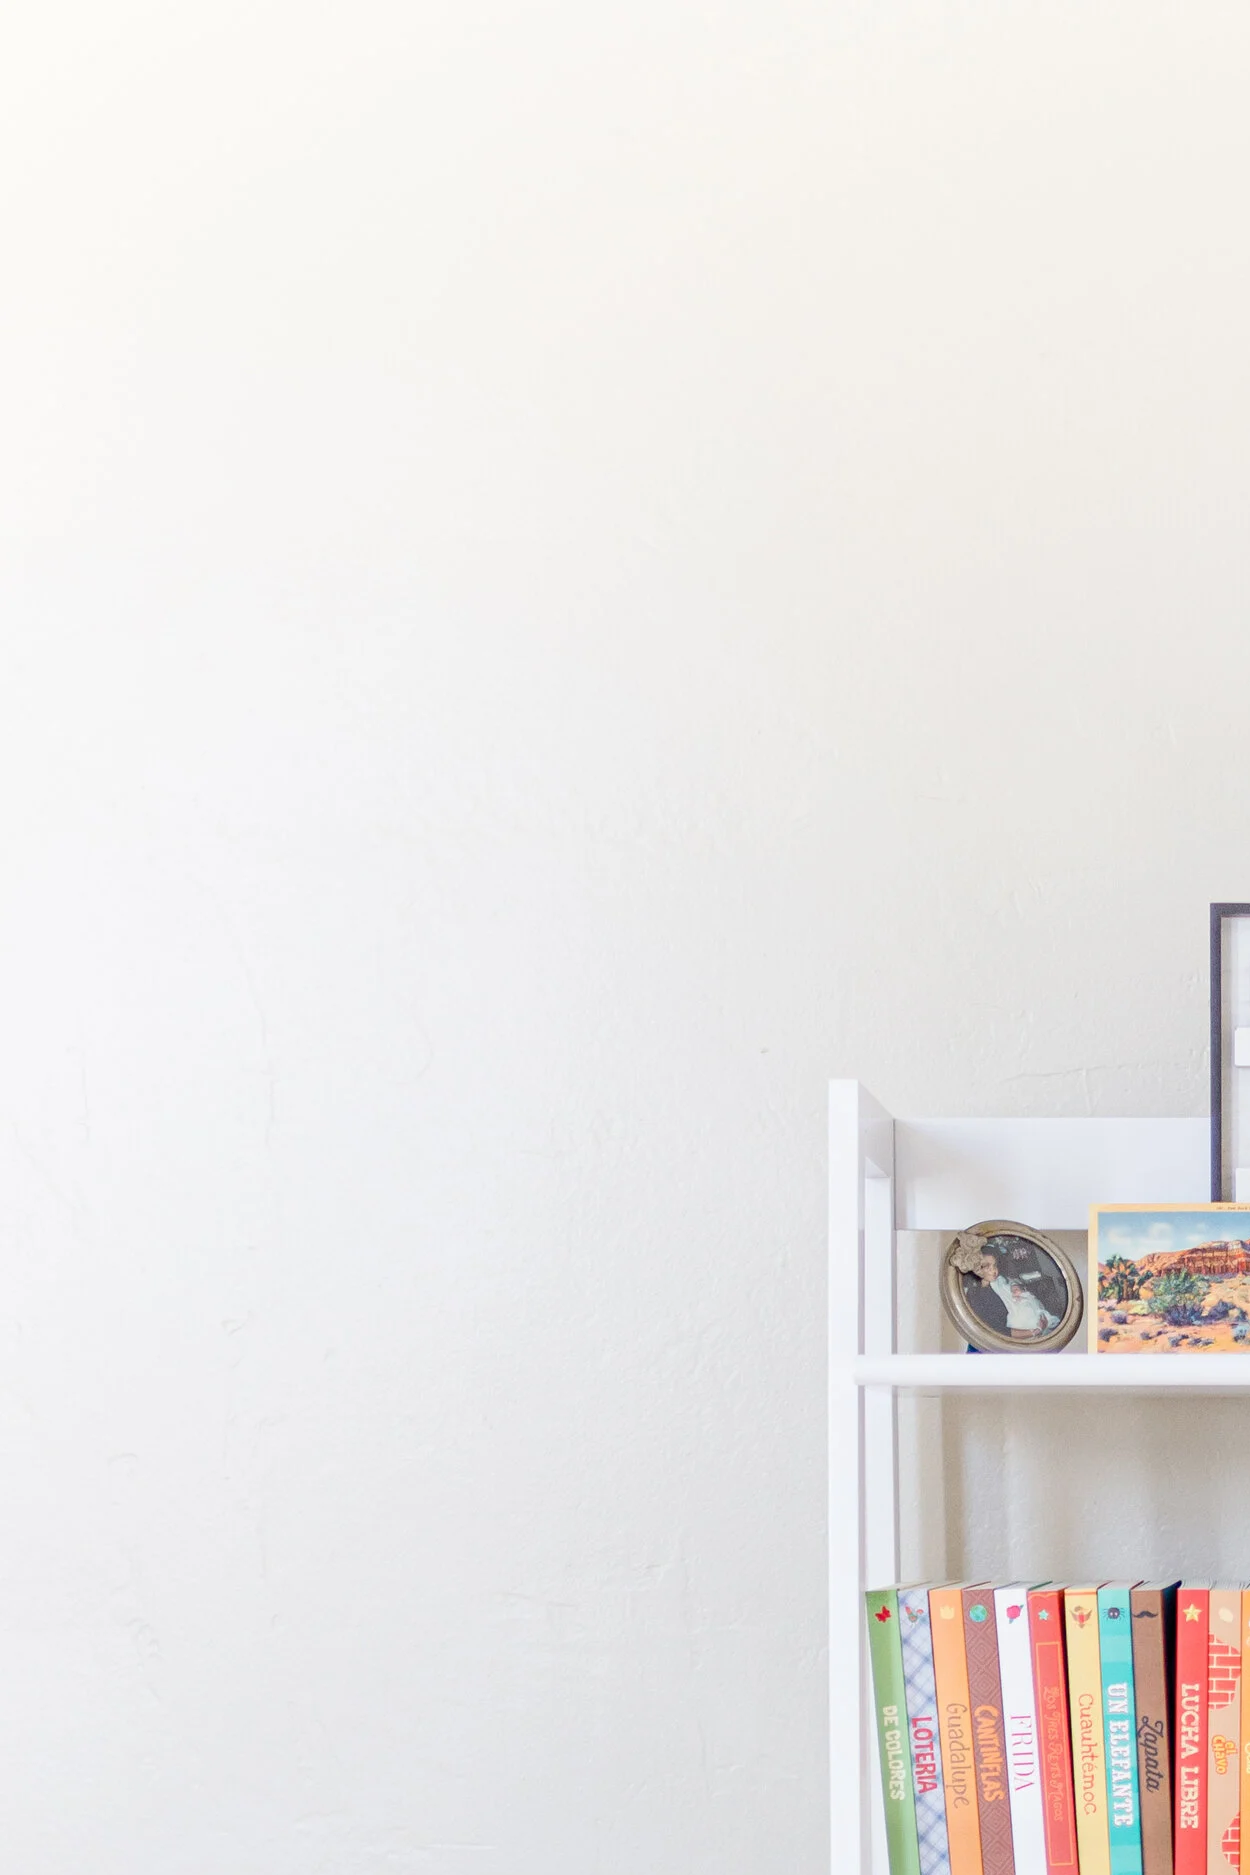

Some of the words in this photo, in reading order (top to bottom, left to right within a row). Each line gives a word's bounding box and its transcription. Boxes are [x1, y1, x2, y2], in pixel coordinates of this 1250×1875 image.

[882, 1705, 899, 1726] DE
[1107, 1682, 1128, 1714] UN
[1180, 1683, 1200, 1760] LUCHA
[885, 1730, 906, 1801] COLORES
[910, 1716, 938, 1794] LOTERIA
[945, 1703, 972, 1809] Guadalupe
[974, 1704, 1006, 1803] CANTINFLAS
[1010, 1714, 1035, 1792] FRIDA
[1078, 1693, 1099, 1815] Cuauhtémoc
[1109, 1720, 1135, 1828] ELEFANTE
[1137, 1715, 1165, 1793] Zapata
[1180, 1767, 1200, 1829] LIBRE
